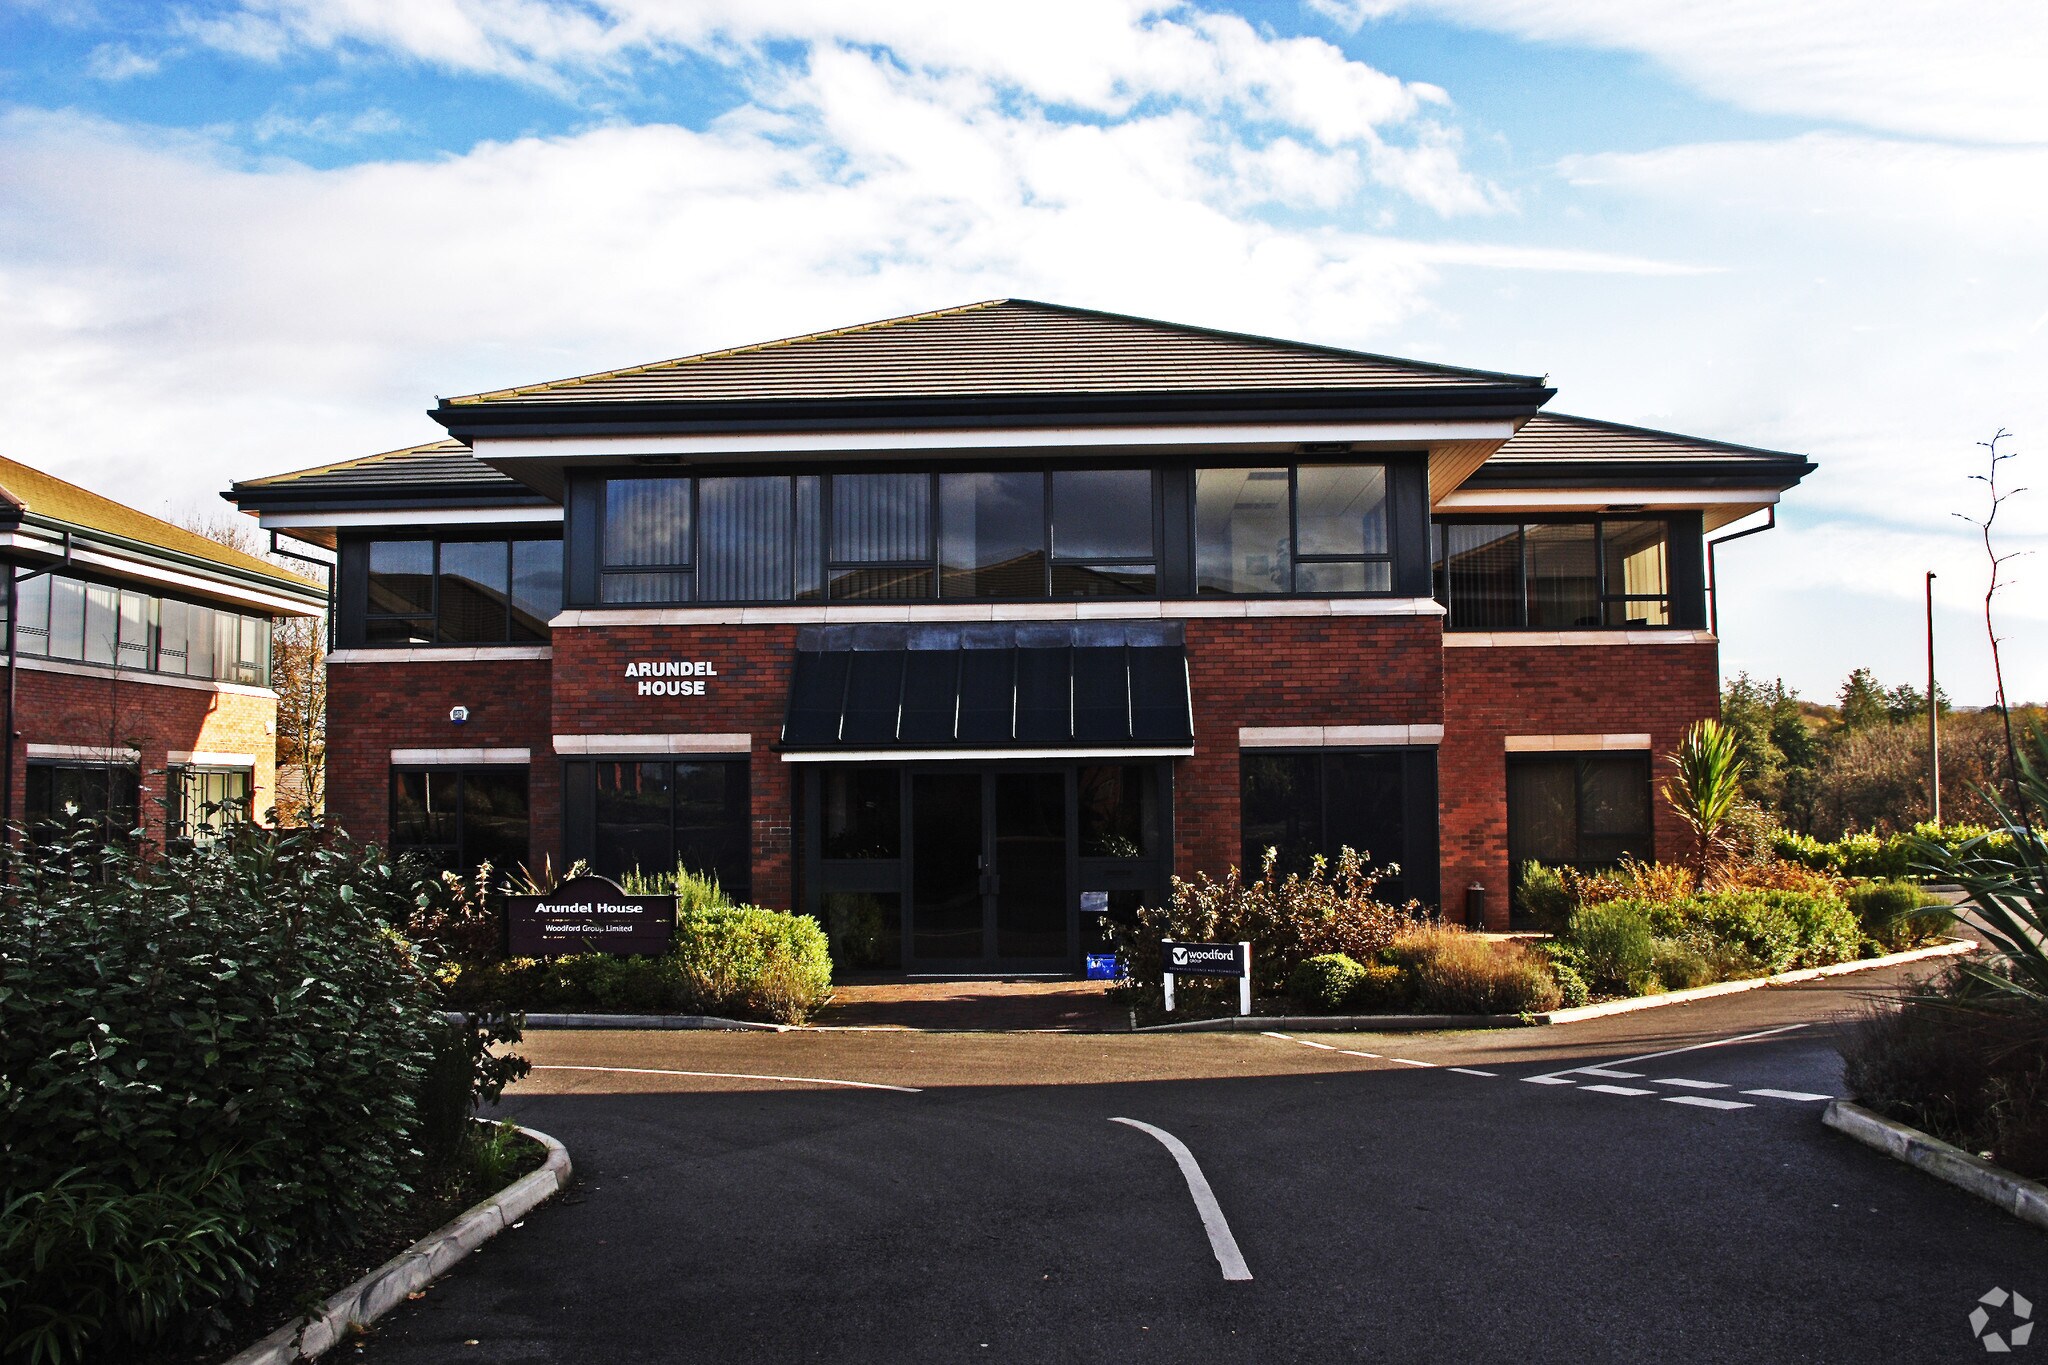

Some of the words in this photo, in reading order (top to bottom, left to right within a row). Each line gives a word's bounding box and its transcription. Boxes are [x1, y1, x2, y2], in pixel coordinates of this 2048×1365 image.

[625, 662, 717, 677] ARUNDEL
[638, 681, 705, 695] HOUSE
[535, 903, 592, 913] Arundel
[597, 903, 643, 913] House
[545, 924, 581, 932] Woodford
[605, 924, 633, 932] Limited
[1188, 949, 1234, 960] woodford
